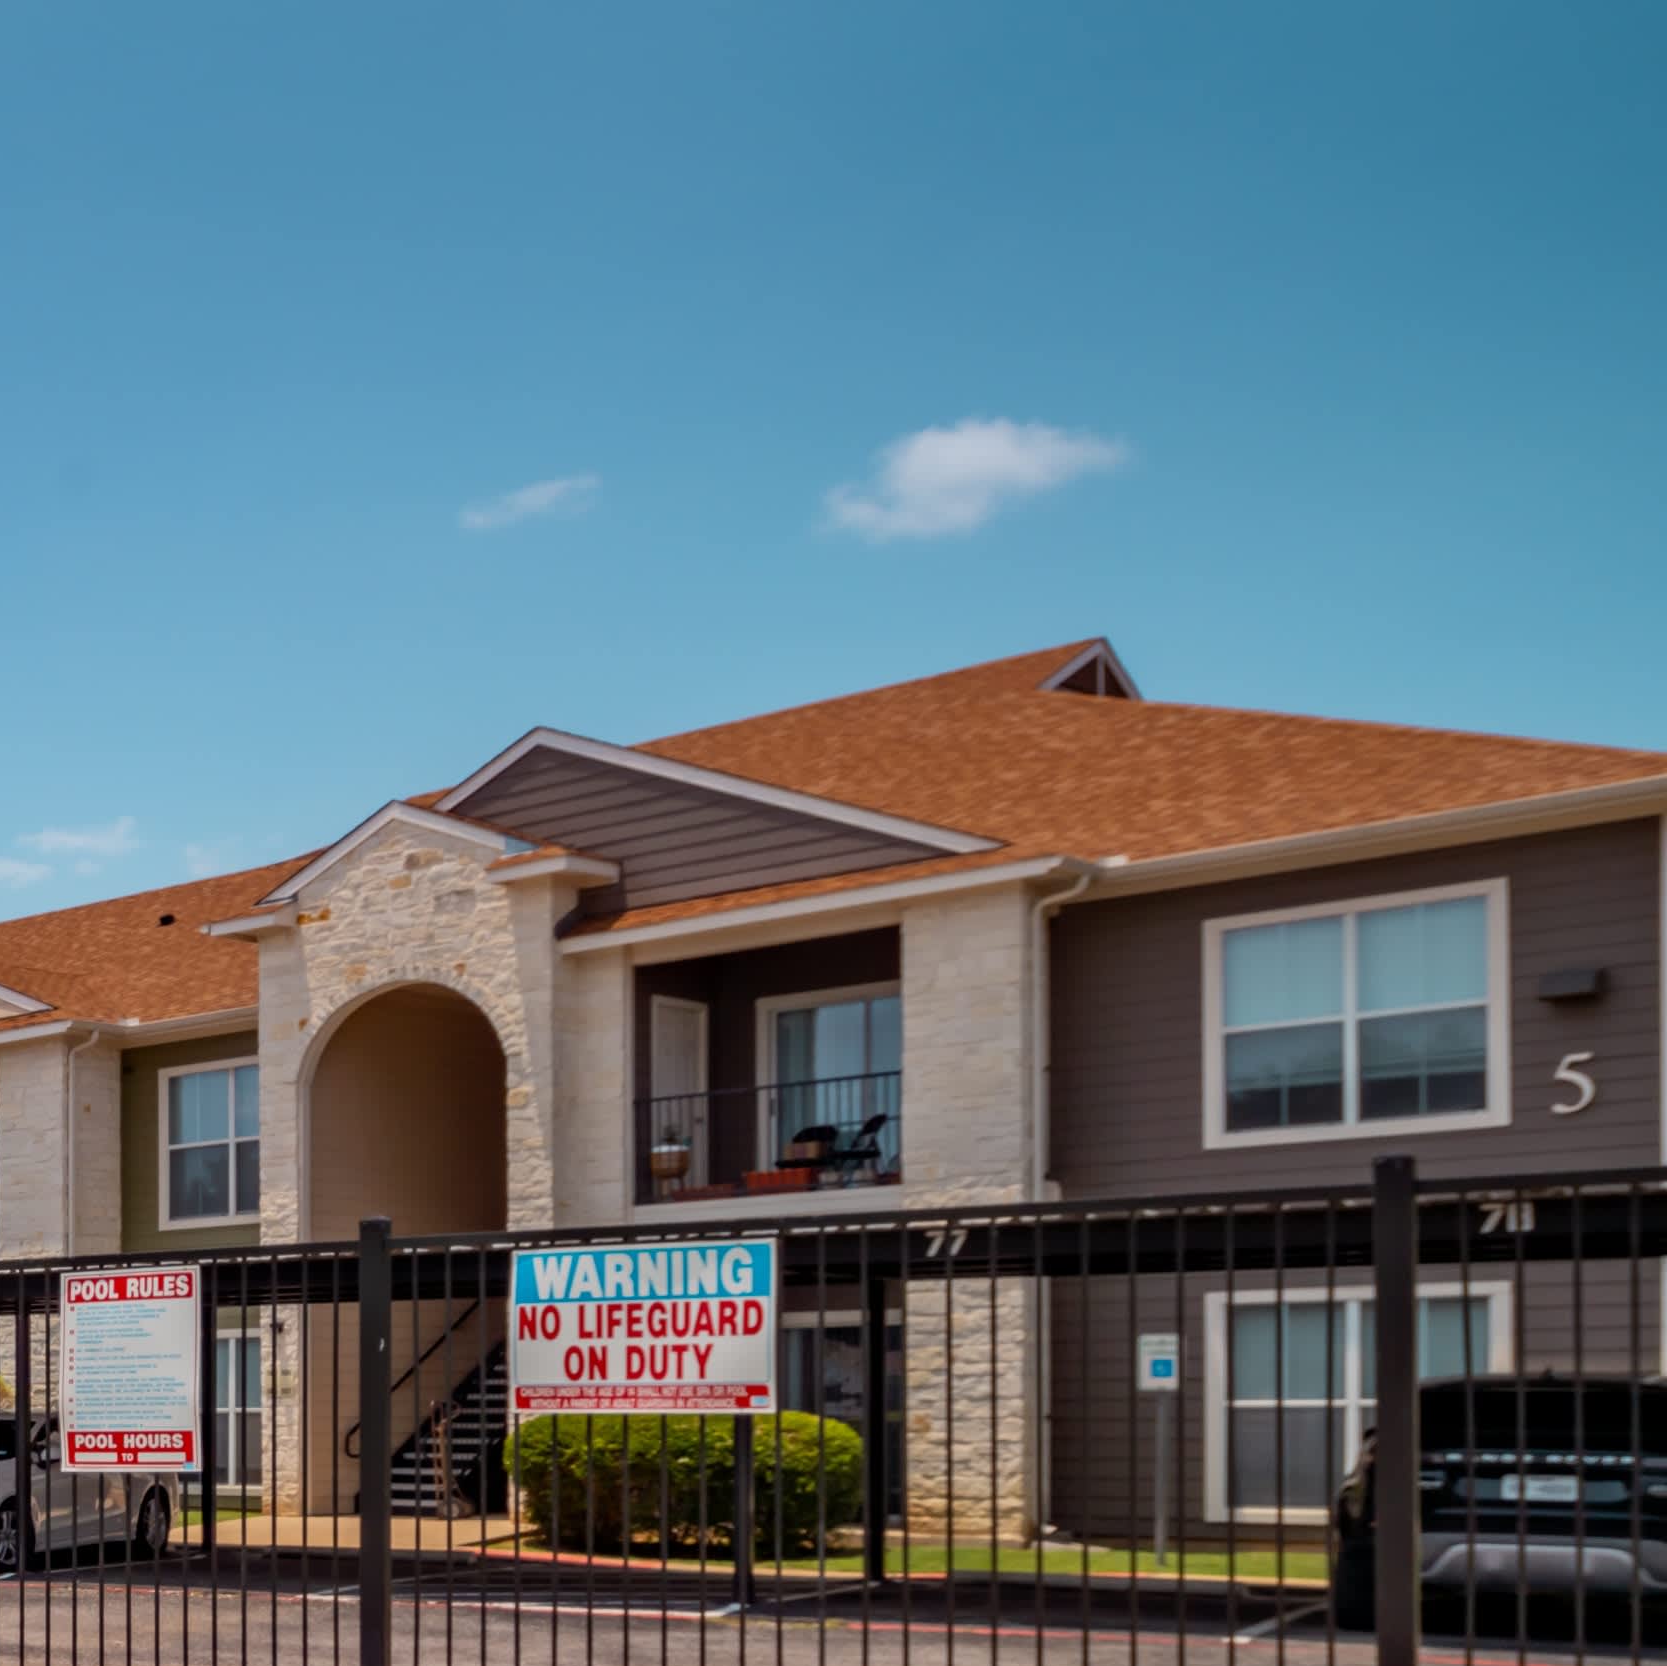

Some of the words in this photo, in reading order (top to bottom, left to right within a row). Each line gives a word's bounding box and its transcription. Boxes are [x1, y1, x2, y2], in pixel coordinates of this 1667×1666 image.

[1551, 1050, 1595, 1114] 5
[925, 1229, 968, 1258] 77
[70, 1280, 119, 1301] POOL
[127, 1275, 189, 1298] RULES
[532, 1247, 753, 1300] WARNING
[518, 1304, 561, 1340] NO
[578, 1299, 763, 1338] LIFEGUARD
[564, 1345, 607, 1381] ON
[626, 1343, 713, 1380] DUTY
[74, 1434, 116, 1449] POOL
[123, 1433, 183, 1449] HOURS
[122, 1453, 134, 1462] TO
